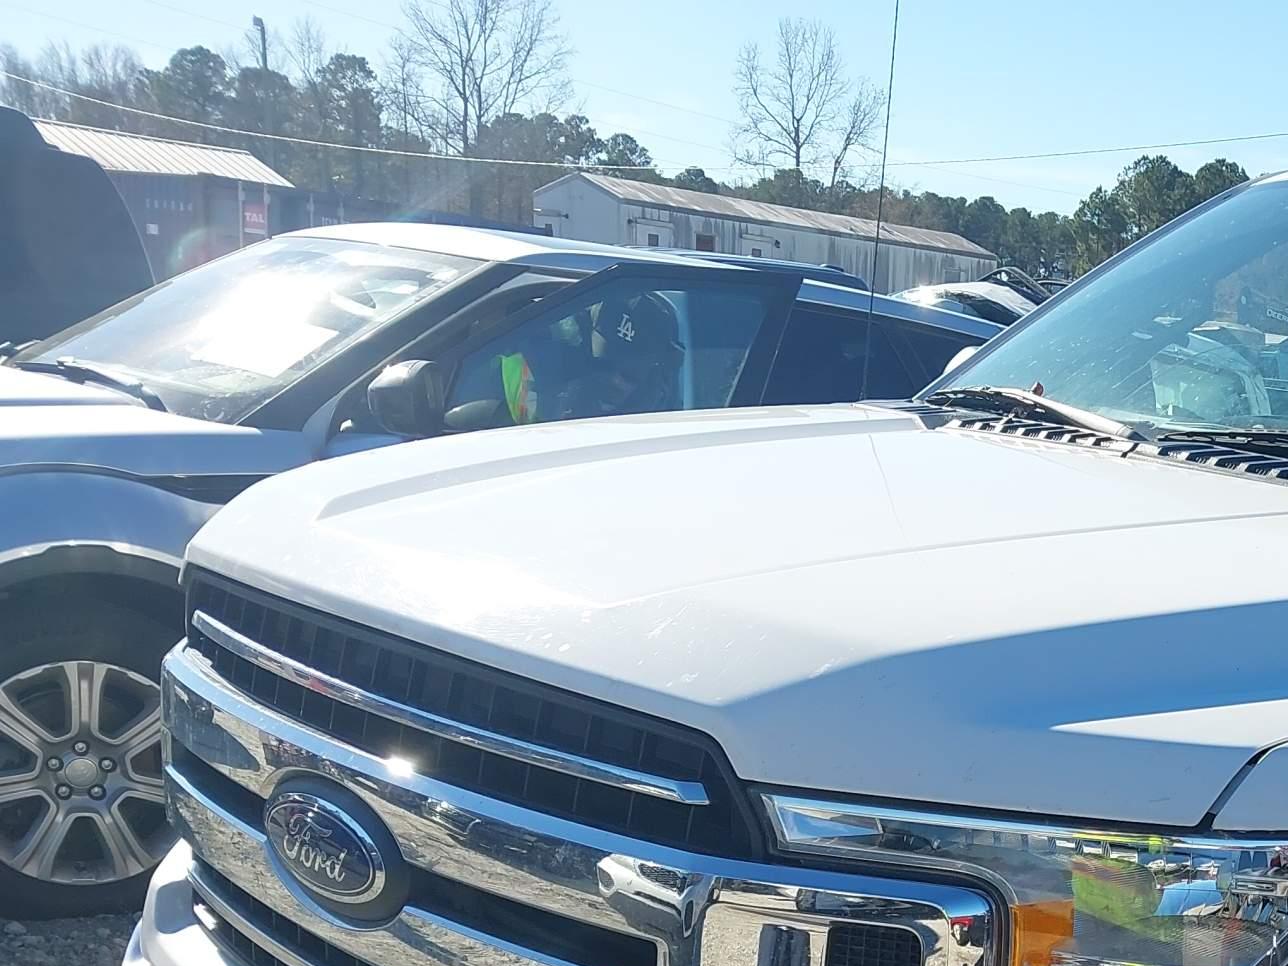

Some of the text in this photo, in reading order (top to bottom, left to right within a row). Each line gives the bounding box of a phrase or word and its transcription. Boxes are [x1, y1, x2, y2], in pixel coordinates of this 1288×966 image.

[244, 211, 265, 223] TAL
[617, 313, 635, 342] LA
[283, 813, 348, 882] Ford
